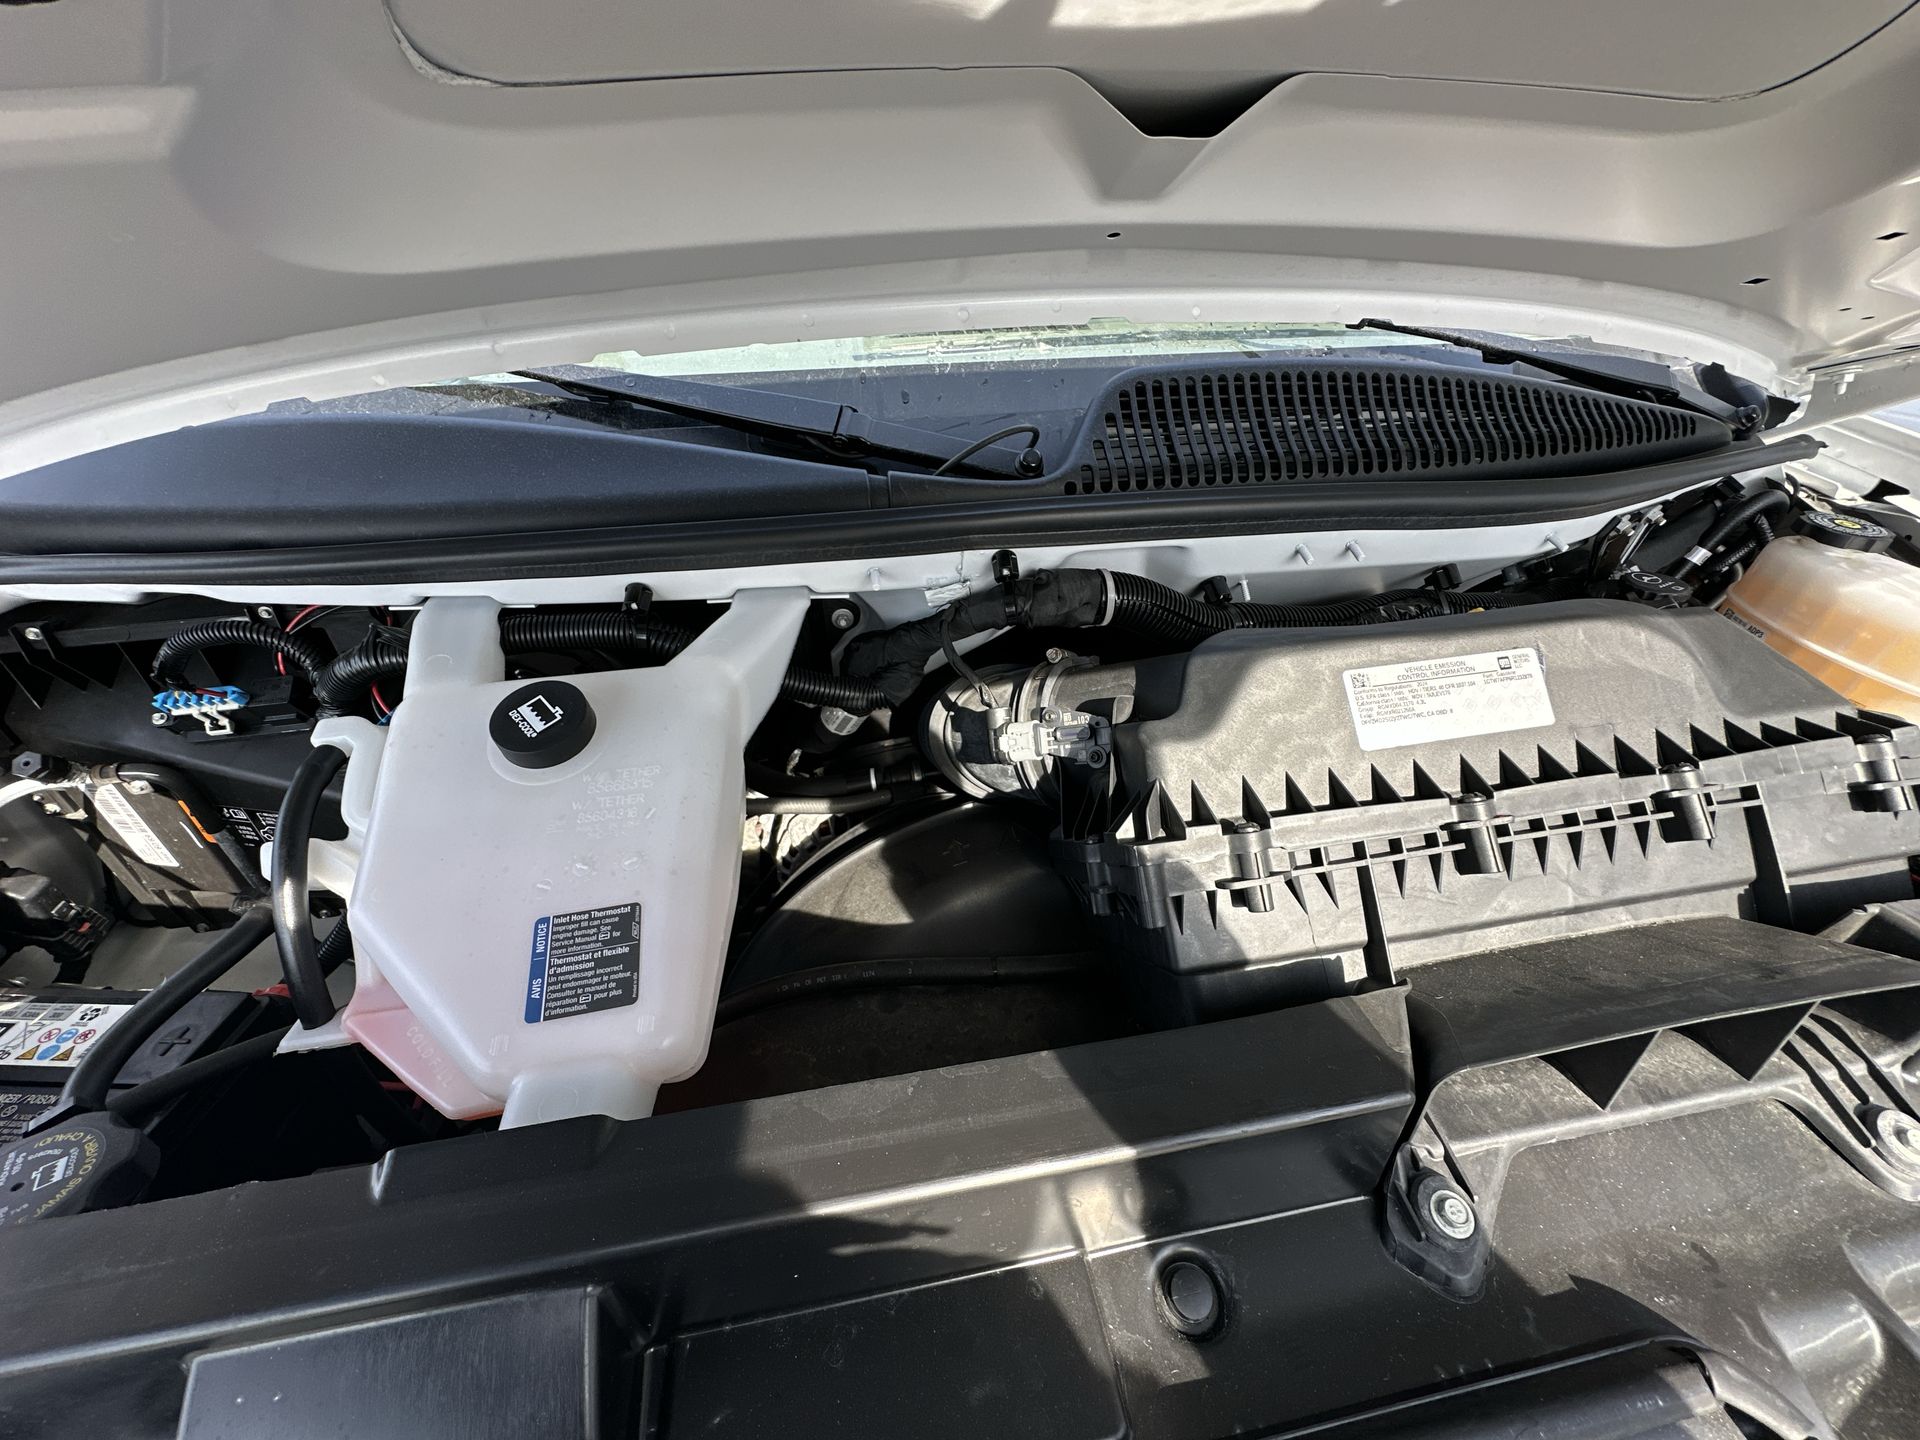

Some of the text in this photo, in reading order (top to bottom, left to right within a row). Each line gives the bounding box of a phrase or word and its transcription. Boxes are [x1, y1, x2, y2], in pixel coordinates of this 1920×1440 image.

[1396, 665, 1476, 681] CONTROL INFORMATION
[1404, 660, 1466, 673] VEHICLE EMISSION
[616, 765, 661, 778] TETHER
[596, 793, 645, 808] TETHER
[554, 915, 570, 924] Inlet
[571, 912, 589, 921] Hose
[591, 906, 631, 918] Thermostat
[553, 922, 579, 932] Improper
[580, 920, 588, 928] fill
[602, 916, 619, 924] cause
[536, 922, 547, 953] NOTICE
[552, 930, 572, 940] engine
[552, 939, 574, 947] Service
[575, 935, 597, 943] Manual
[550, 947, 566, 955] more
[550, 952, 592, 965] Thermostat
[603, 946, 629, 957] flexible
[548, 964, 623, 983] Un remplissage incorrect
[549, 961, 594, 974] d'admission
[531, 978, 542, 998] AVIS
[547, 989, 575, 999] Consulter
[585, 983, 607, 992] manuel
[548, 984, 561, 992] peut
[562, 976, 601, 989] endommager
[594, 992, 608, 1000] pour
[609, 989, 622, 998] plus
[406, 1027, 433, 1057] COLD
[34, 1177, 82, 1217] JAMAIS
